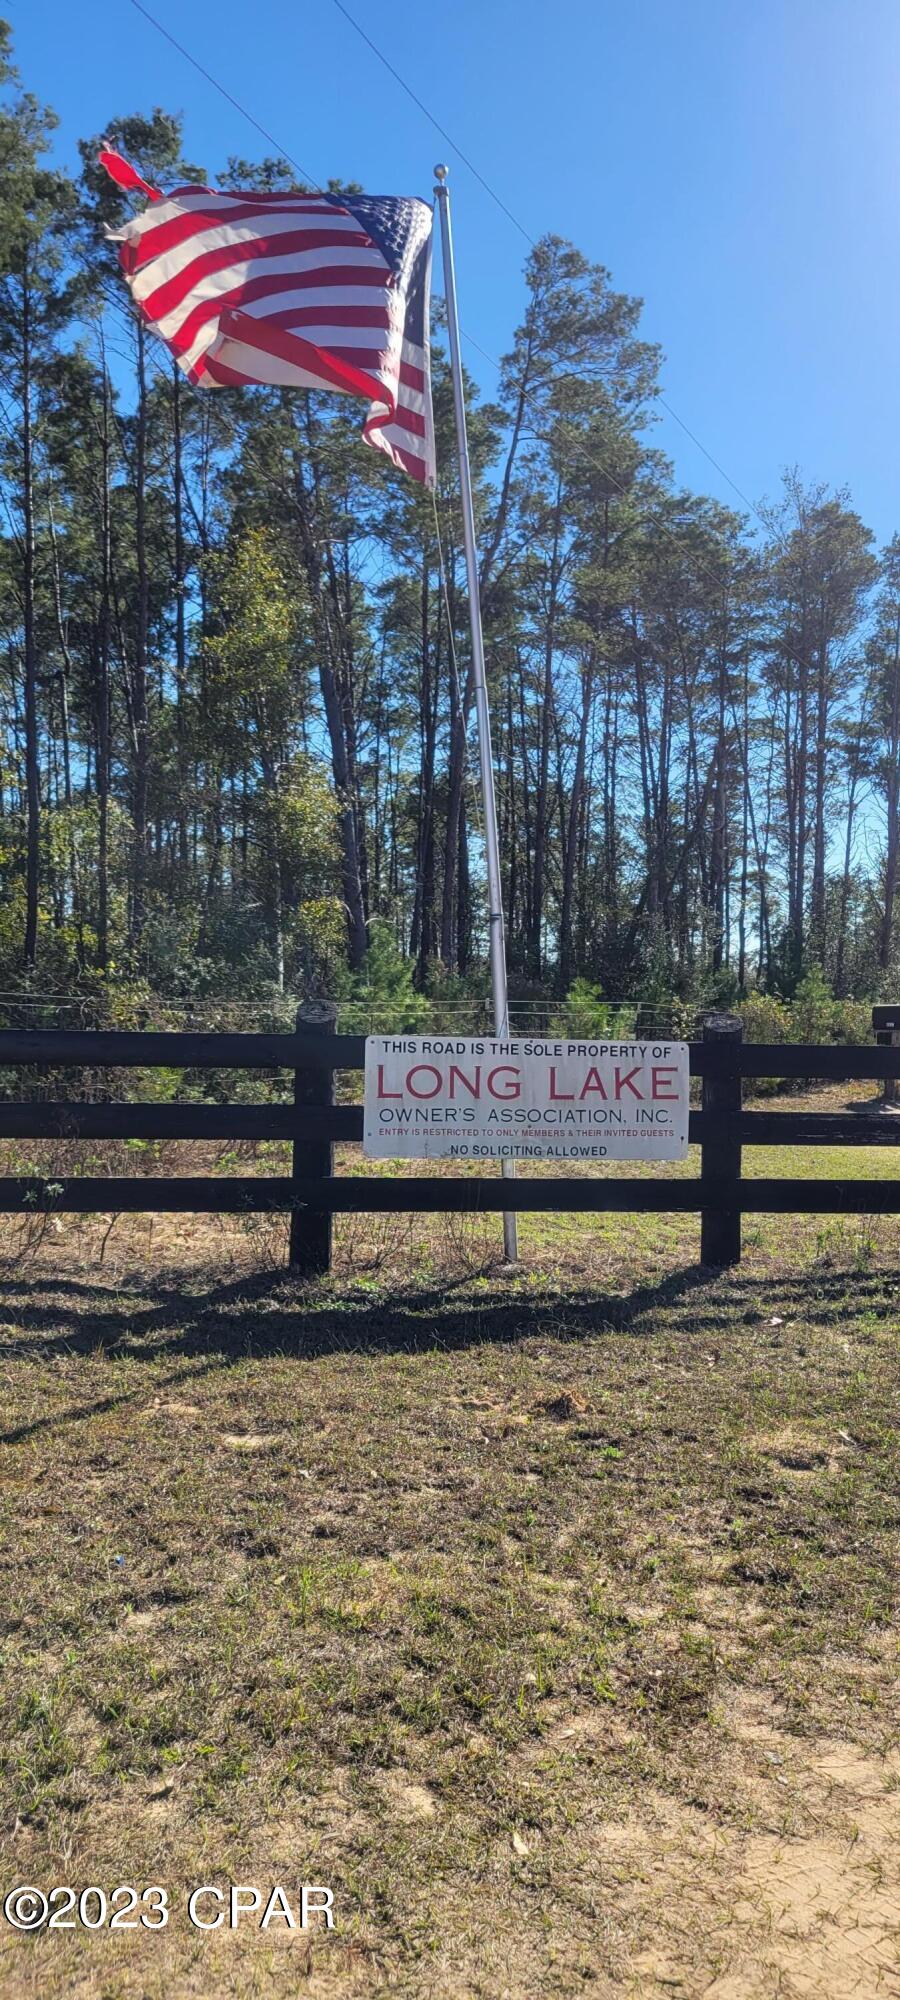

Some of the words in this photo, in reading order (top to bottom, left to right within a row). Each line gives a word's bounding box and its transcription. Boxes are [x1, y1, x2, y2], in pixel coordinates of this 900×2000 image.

[383, 1041, 416, 1054] THIS
[422, 1042, 466, 1054] ROAD
[471, 1042, 485, 1055] IS
[490, 1043, 519, 1056] THE
[524, 1044, 562, 1056] SOLE
[567, 1045, 648, 1058] PROPERTY
[652, 1047, 671, 1058] OF
[377, 1064, 522, 1100] LONG
[549, 1066, 679, 1100] LAKE
[379, 1108, 476, 1123] OWNER'S
[487, 1109, 627, 1123] ASSOCIATION,
[636, 1109, 673, 1123] INC.
[379, 1128, 409, 1136] ENTRY
[412, 1128, 420, 1136] IS
[423, 1128, 479, 1137] RESTRICTED
[482, 1129, 493, 1137] TO
[496, 1129, 518, 1137] ONLY
[521, 1129, 565, 1137] MEMBERS
[568, 1129, 574, 1137] &
[576, 1129, 602, 1137] THEIR
[604, 1129, 638, 1137] INVITED
[640, 1129, 674, 1137] GUESTS
[450, 1145, 469, 1155] NO
[472, 1145, 542, 1156] SOLICITING
[546, 1146, 608, 1157] ALLOWED
